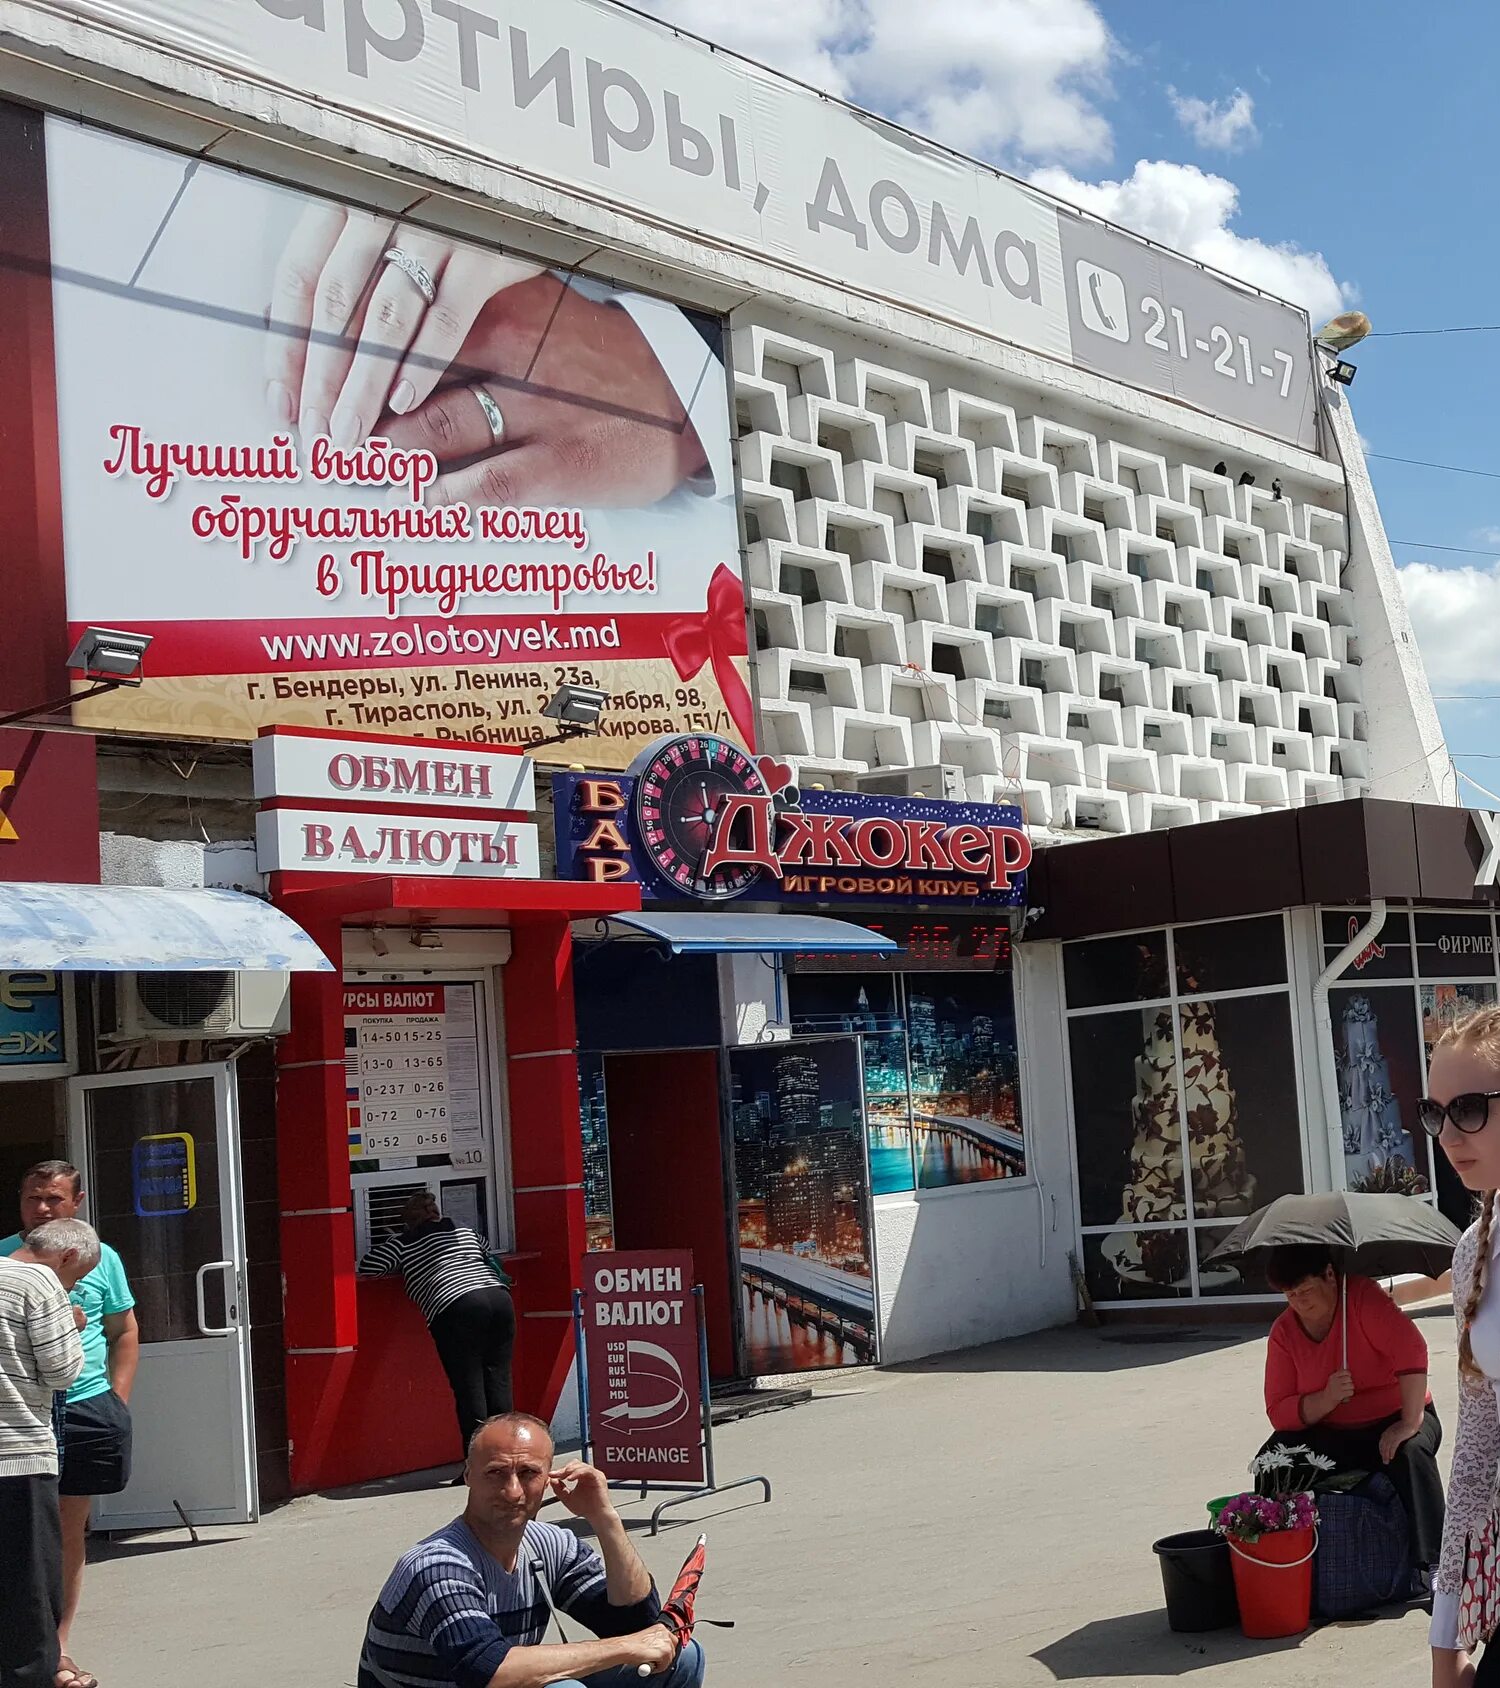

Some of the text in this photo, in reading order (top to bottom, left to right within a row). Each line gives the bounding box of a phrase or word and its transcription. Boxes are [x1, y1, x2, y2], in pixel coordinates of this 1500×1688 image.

[805, 156, 1042, 305] дома
[1140, 296, 1293, 398] 21-21-7
[104, 425, 437, 502] Лучший выбор
[192, 495, 586, 560] обручальных колец
[316, 550, 656, 616] в Приднестровье!
[260, 619, 621, 661] www.zolotoyvek.md
[247, 682, 266, 700] г.
[273, 676, 404, 700] Бендеры,
[410, 676, 447, 697] ул.
[455, 670, 549, 692] Ленина,
[326, 708, 343, 726] г.
[348, 701, 491, 727] Тирасполь,
[496, 698, 531, 720] ул.
[675, 688, 707, 710] 98,
[329, 753, 493, 798] ОБМЕН
[304, 823, 519, 868] ВАЛЮТЫ
[703, 793, 1033, 890] Джокер
[783, 875, 979, 896] ИГРОВОЙ КЛУБ
[384, 992, 435, 1007] ВАЛЮТ
[363, 1016, 439, 1024] ПОКУПКА ПРОДАЖА
[363, 1030, 442, 1043] 14-50 15-25
[363, 1056, 443, 1070] 13-0 13-65
[366, 1081, 444, 1096] 0-237 0-26
[367, 1107, 446, 1122] 0-72 0-76
[369, 1133, 447, 1148] 0-52 0-56
[594, 1267, 682, 1293] ОБМЕН
[596, 1300, 684, 1326] ВАЛЮТ
[607, 1342, 625, 1351] USD
[608, 1355, 624, 1363] EUR
[608, 1367, 625, 1375] RUS
[609, 1378, 627, 1387] UAH
[610, 1391, 629, 1399] MDL
[606, 1447, 690, 1463] EXCHANGE
